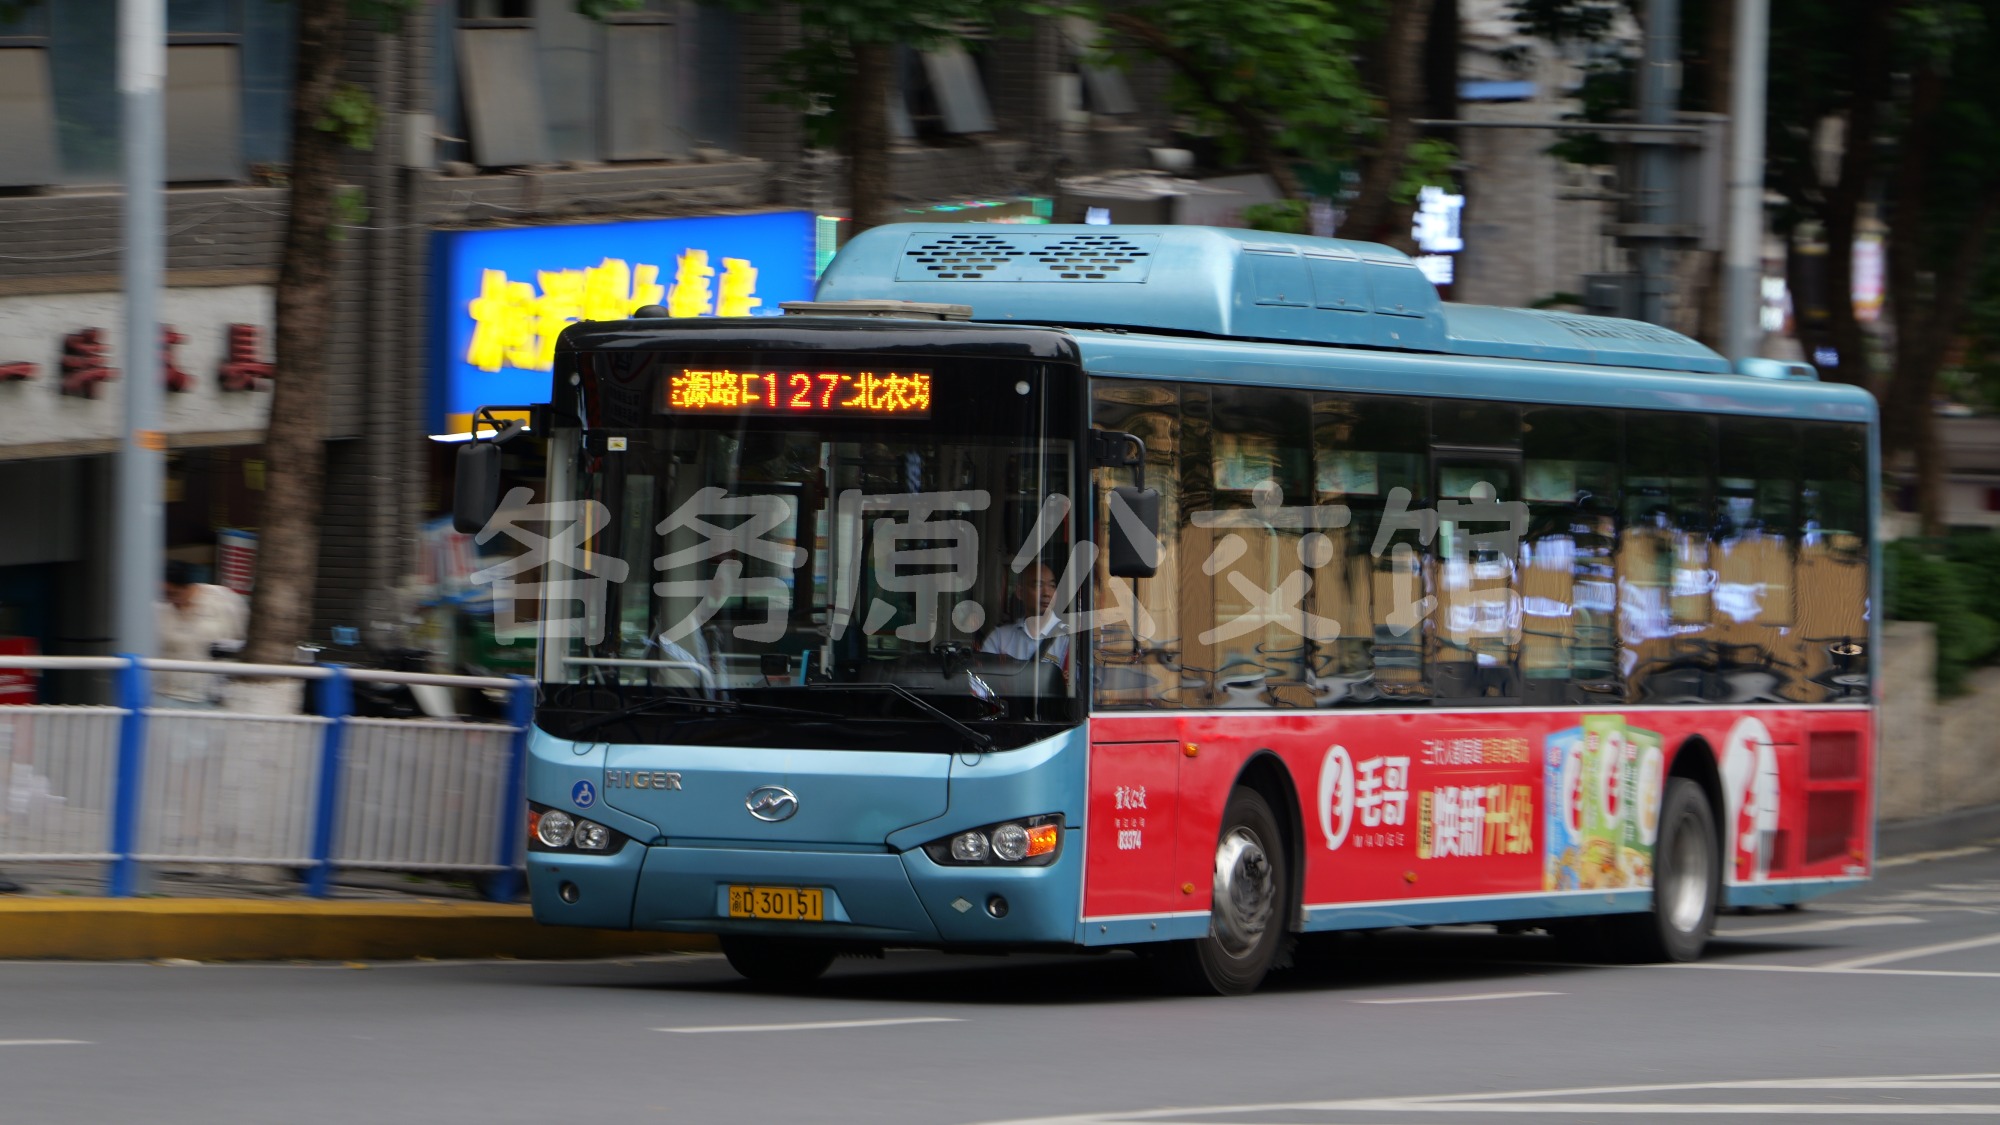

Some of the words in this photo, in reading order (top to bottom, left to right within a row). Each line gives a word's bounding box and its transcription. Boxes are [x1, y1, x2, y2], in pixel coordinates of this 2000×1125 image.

[764, 373, 839, 408] 127
[606, 770, 682, 791] HIGER
[1355, 756, 1411, 827] 毛哥
